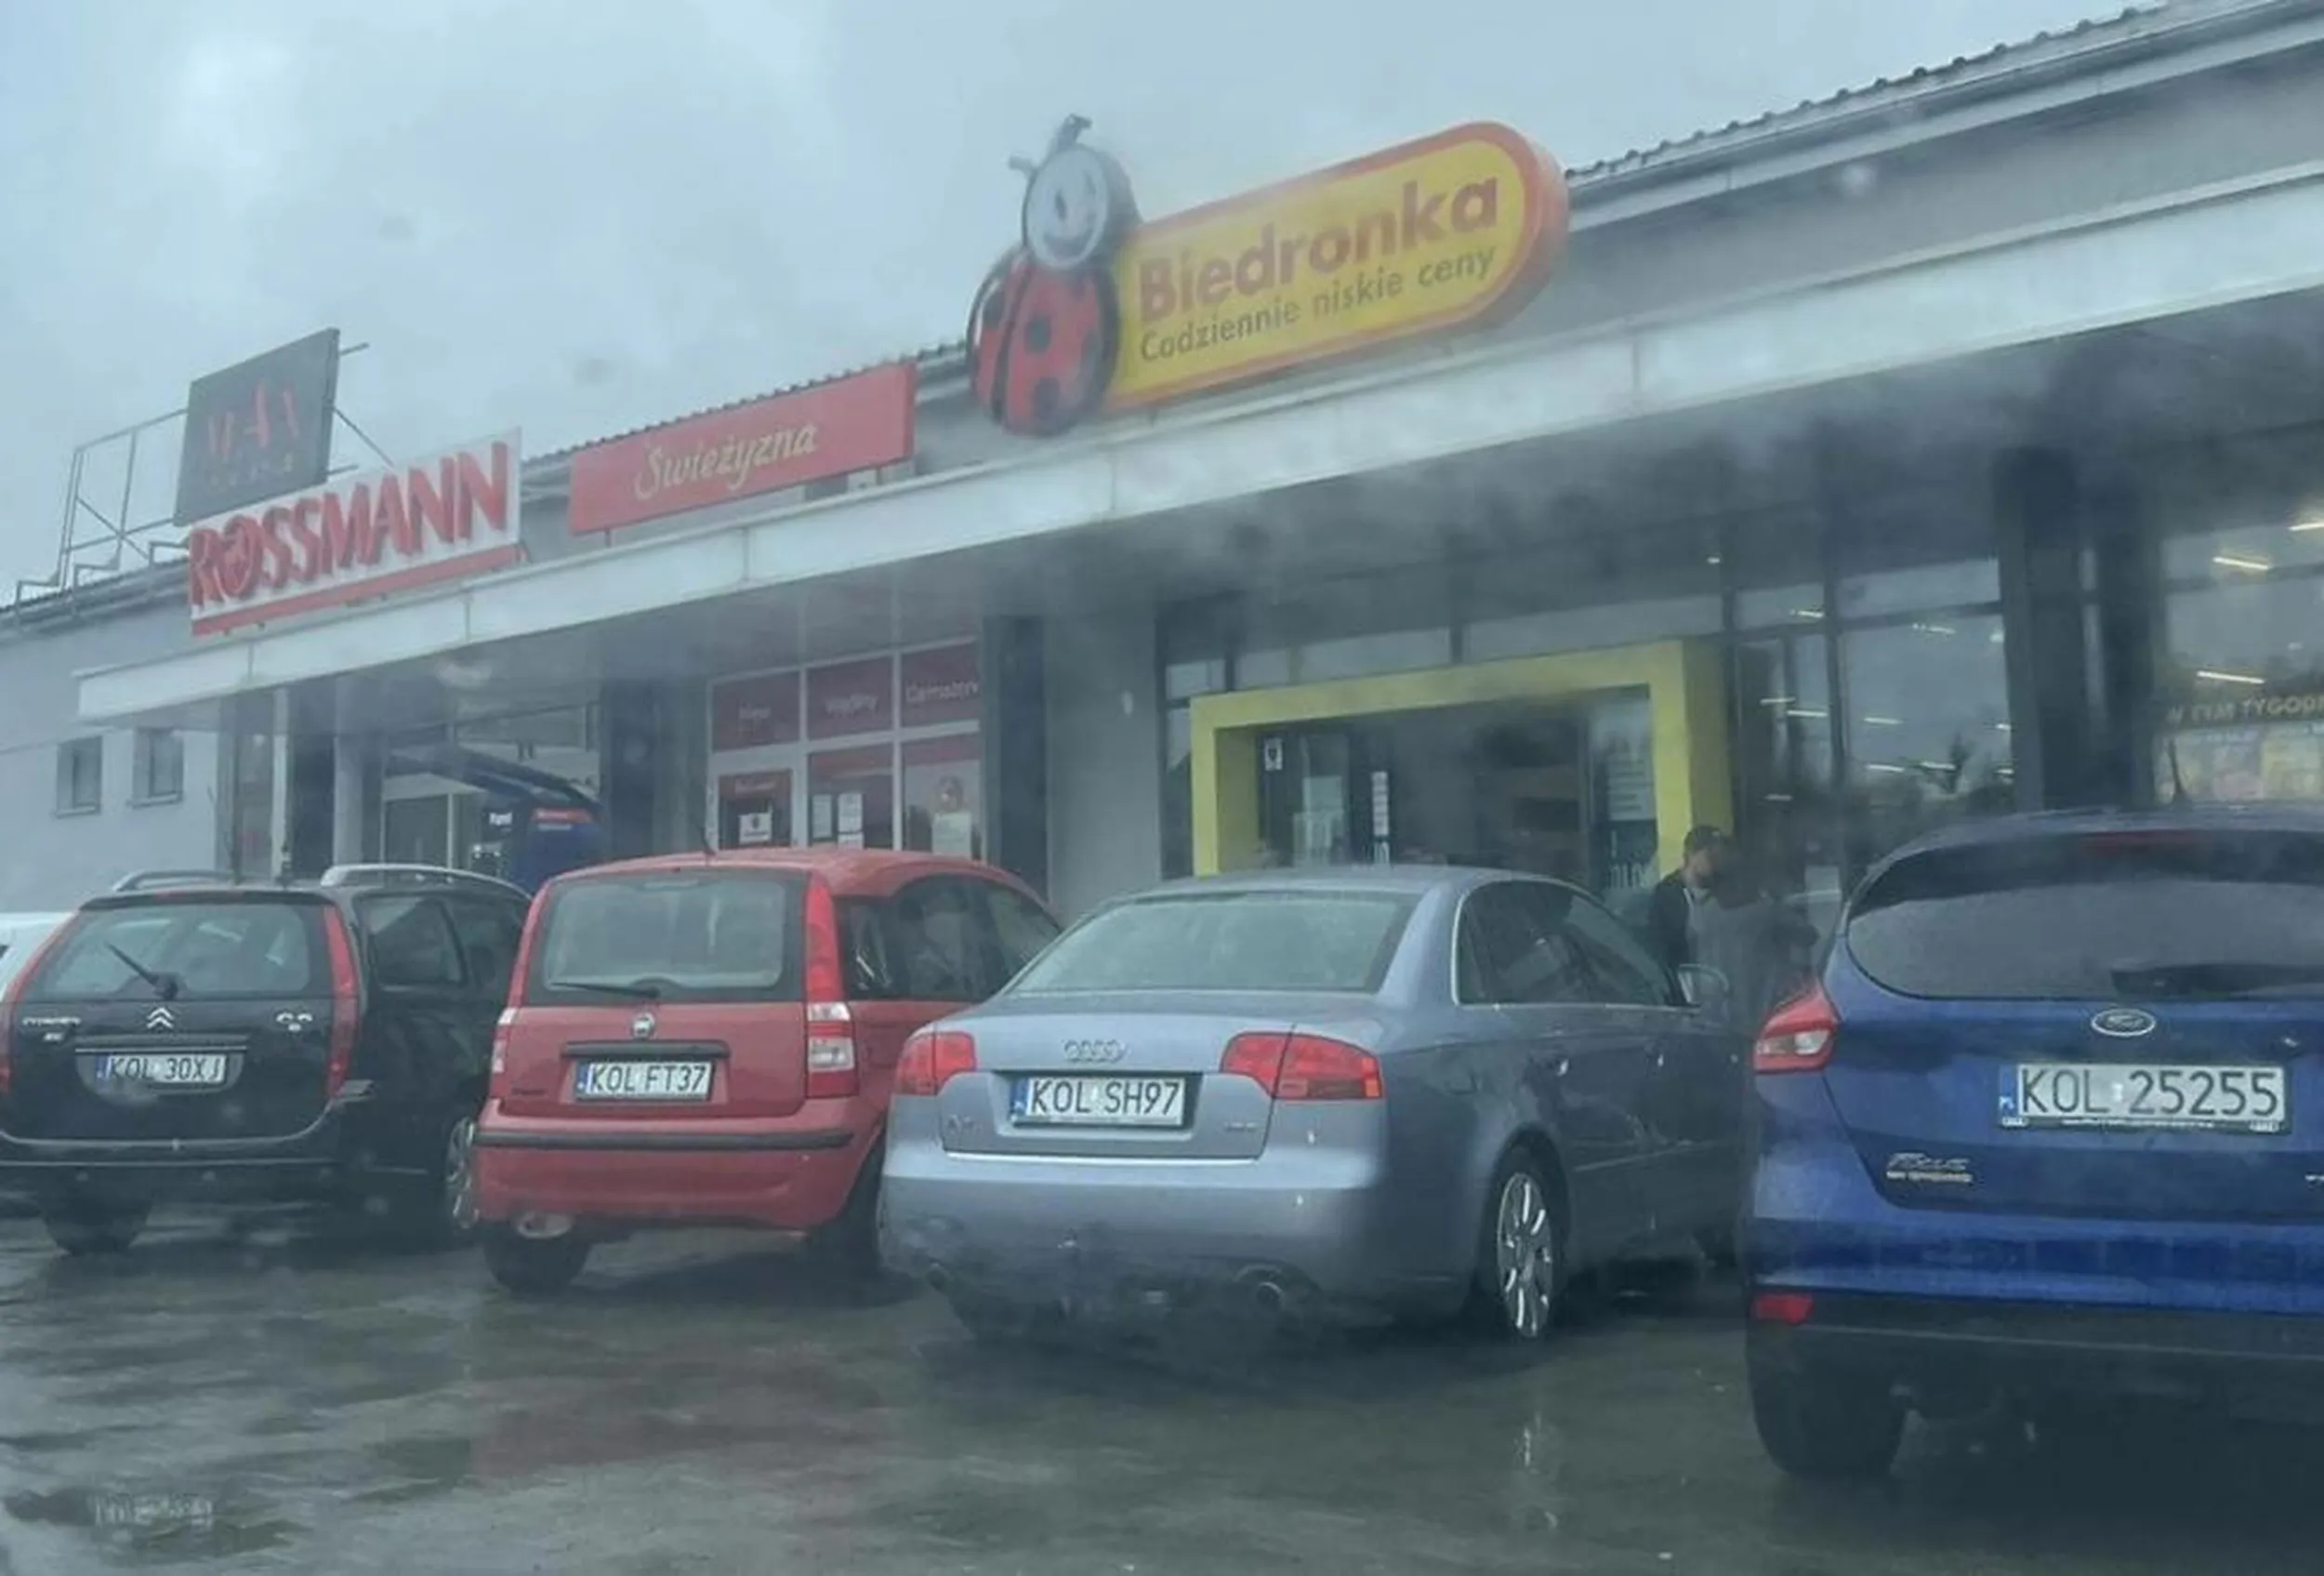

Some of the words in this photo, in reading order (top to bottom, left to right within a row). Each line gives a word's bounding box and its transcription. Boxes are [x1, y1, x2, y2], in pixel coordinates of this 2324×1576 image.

[1138, 178, 1499, 325] Biedronka
[1140, 295, 1301, 363] Codziennie
[1312, 261, 1404, 317] niskie
[1418, 245, 1498, 288] ceny
[189, 442, 508, 606] ROSSMANN
[109, 1057, 154, 1079] KOL
[591, 1065, 635, 1092] KOL
[644, 1066, 706, 1092] FT37
[2021, 1068, 2109, 1114] KOL
[2128, 1070, 2279, 1117] 25255
[1031, 1080, 1091, 1114] KOL
[1104, 1081, 1181, 1116] SH97
